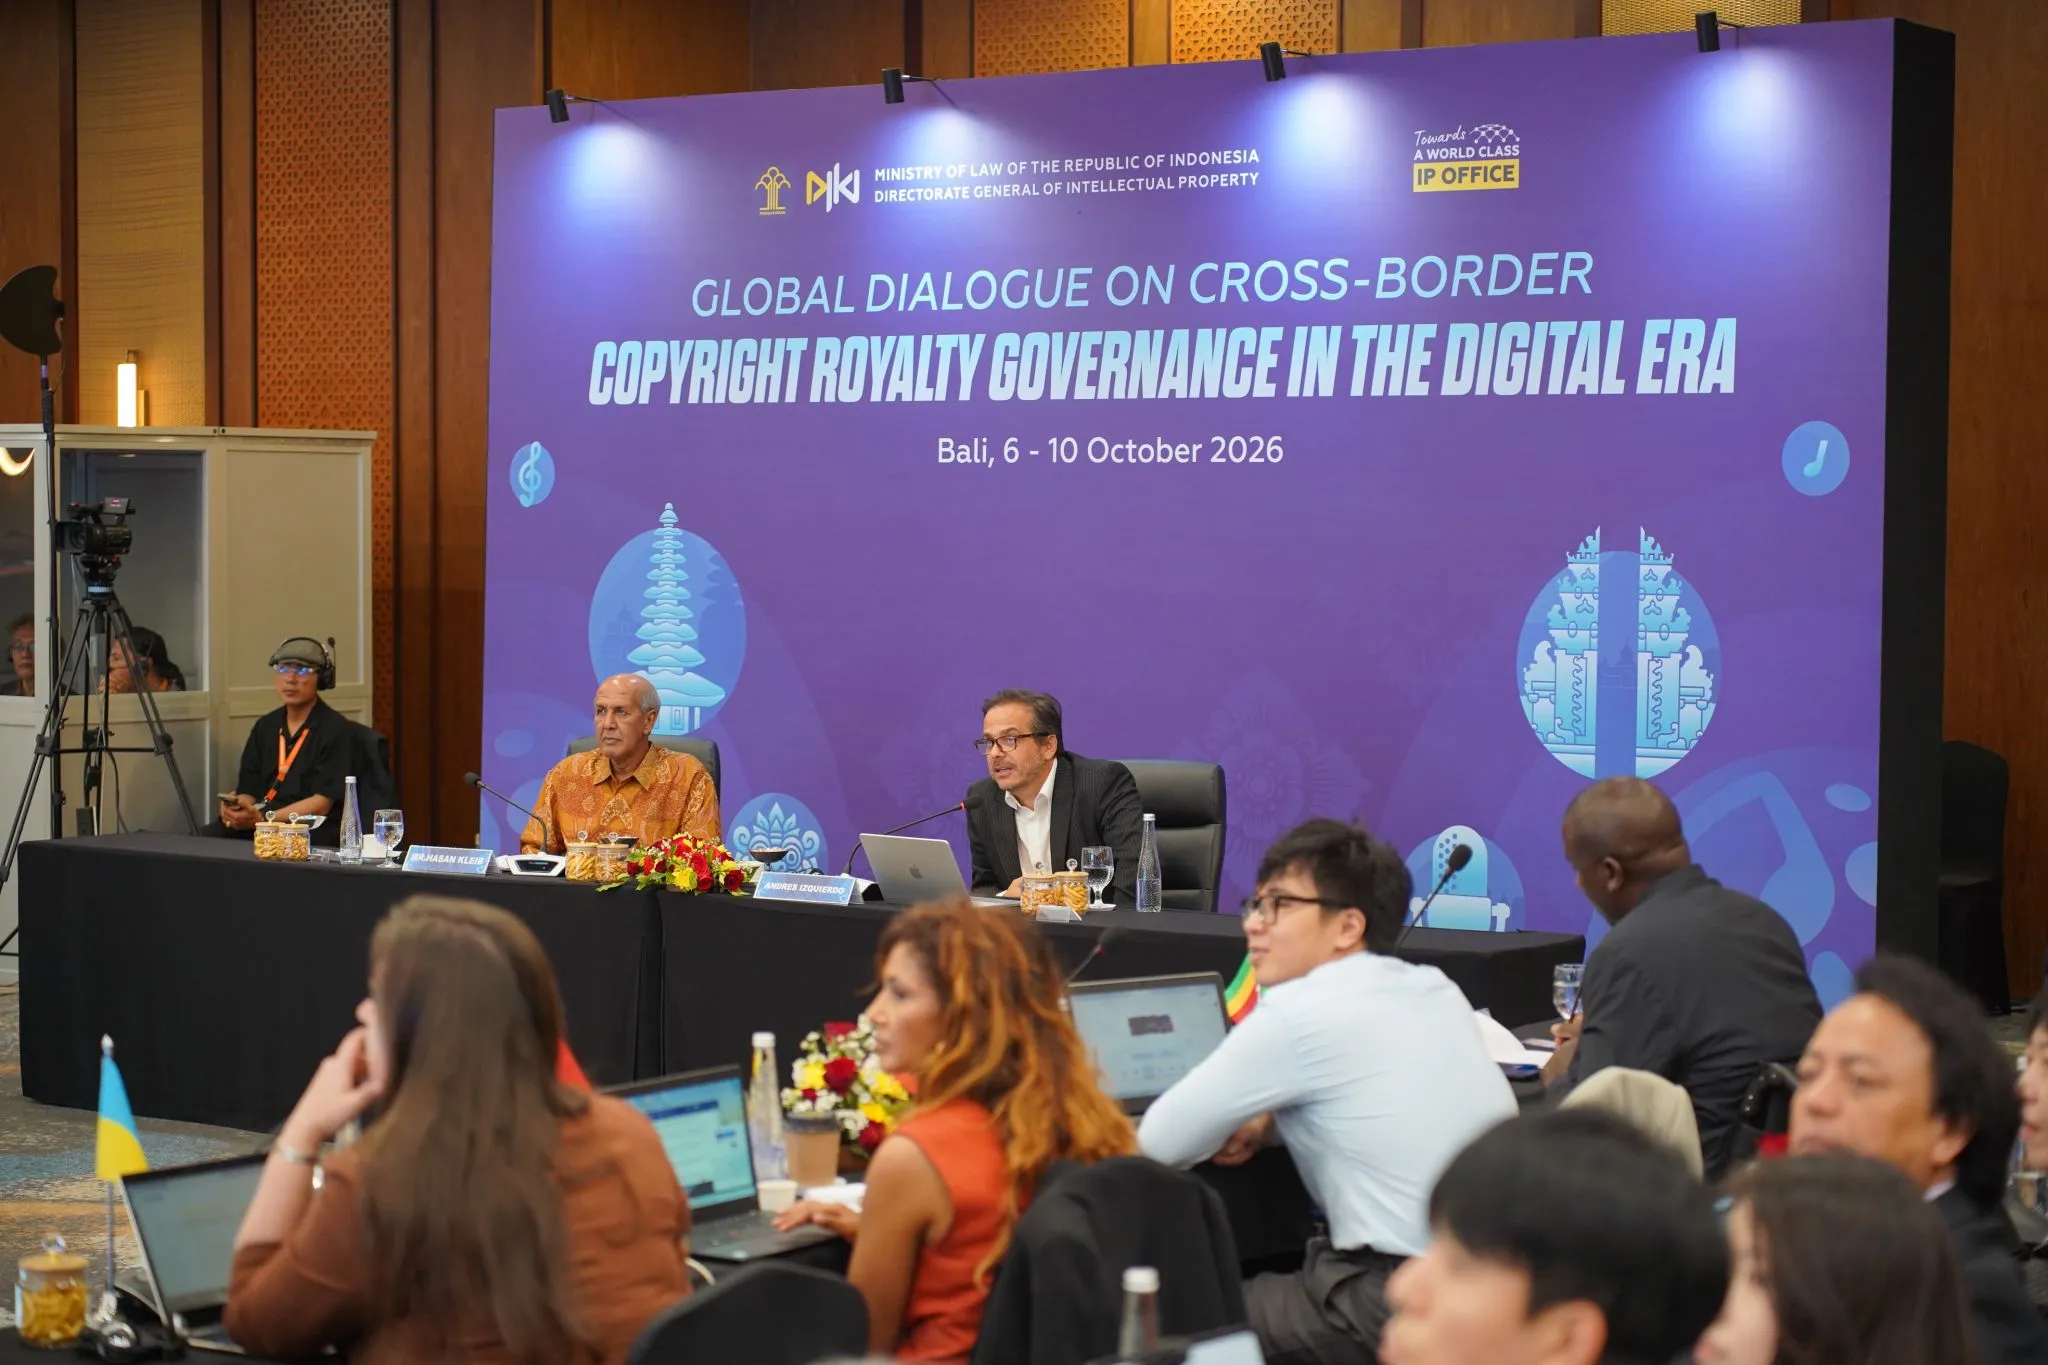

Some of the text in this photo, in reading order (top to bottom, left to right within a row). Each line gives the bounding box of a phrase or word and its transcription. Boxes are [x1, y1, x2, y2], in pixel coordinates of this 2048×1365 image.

[1414, 125, 1466, 146] Towards
[875, 149, 1260, 181] MINISTRY OF LAW OF THE REPUBLIC OF INDONESIA
[1413, 145, 1520, 160] A WORLD CLASS
[874, 172, 1260, 203] DIRECTORATE GENERAL OF INTELLECTUAL PROPERTY
[1417, 164, 1515, 185] IP OFFICE
[692, 252, 1594, 317] GLOBAL DIALOGUE ON CROSS-BORDER
[588, 317, 1737, 405] COPYRIGHT ROYALTY GOVERNANCE IN THE DIGITAL ERA
[937, 436, 995, 468] Bali,
[1003, 437, 1020, 464] 6
[1048, 436, 1079, 464] 10
[1087, 436, 1203, 464] October
[1210, 435, 1284, 464] 2026
[764, 882, 845, 894] ANDRES IZQUIERDO
